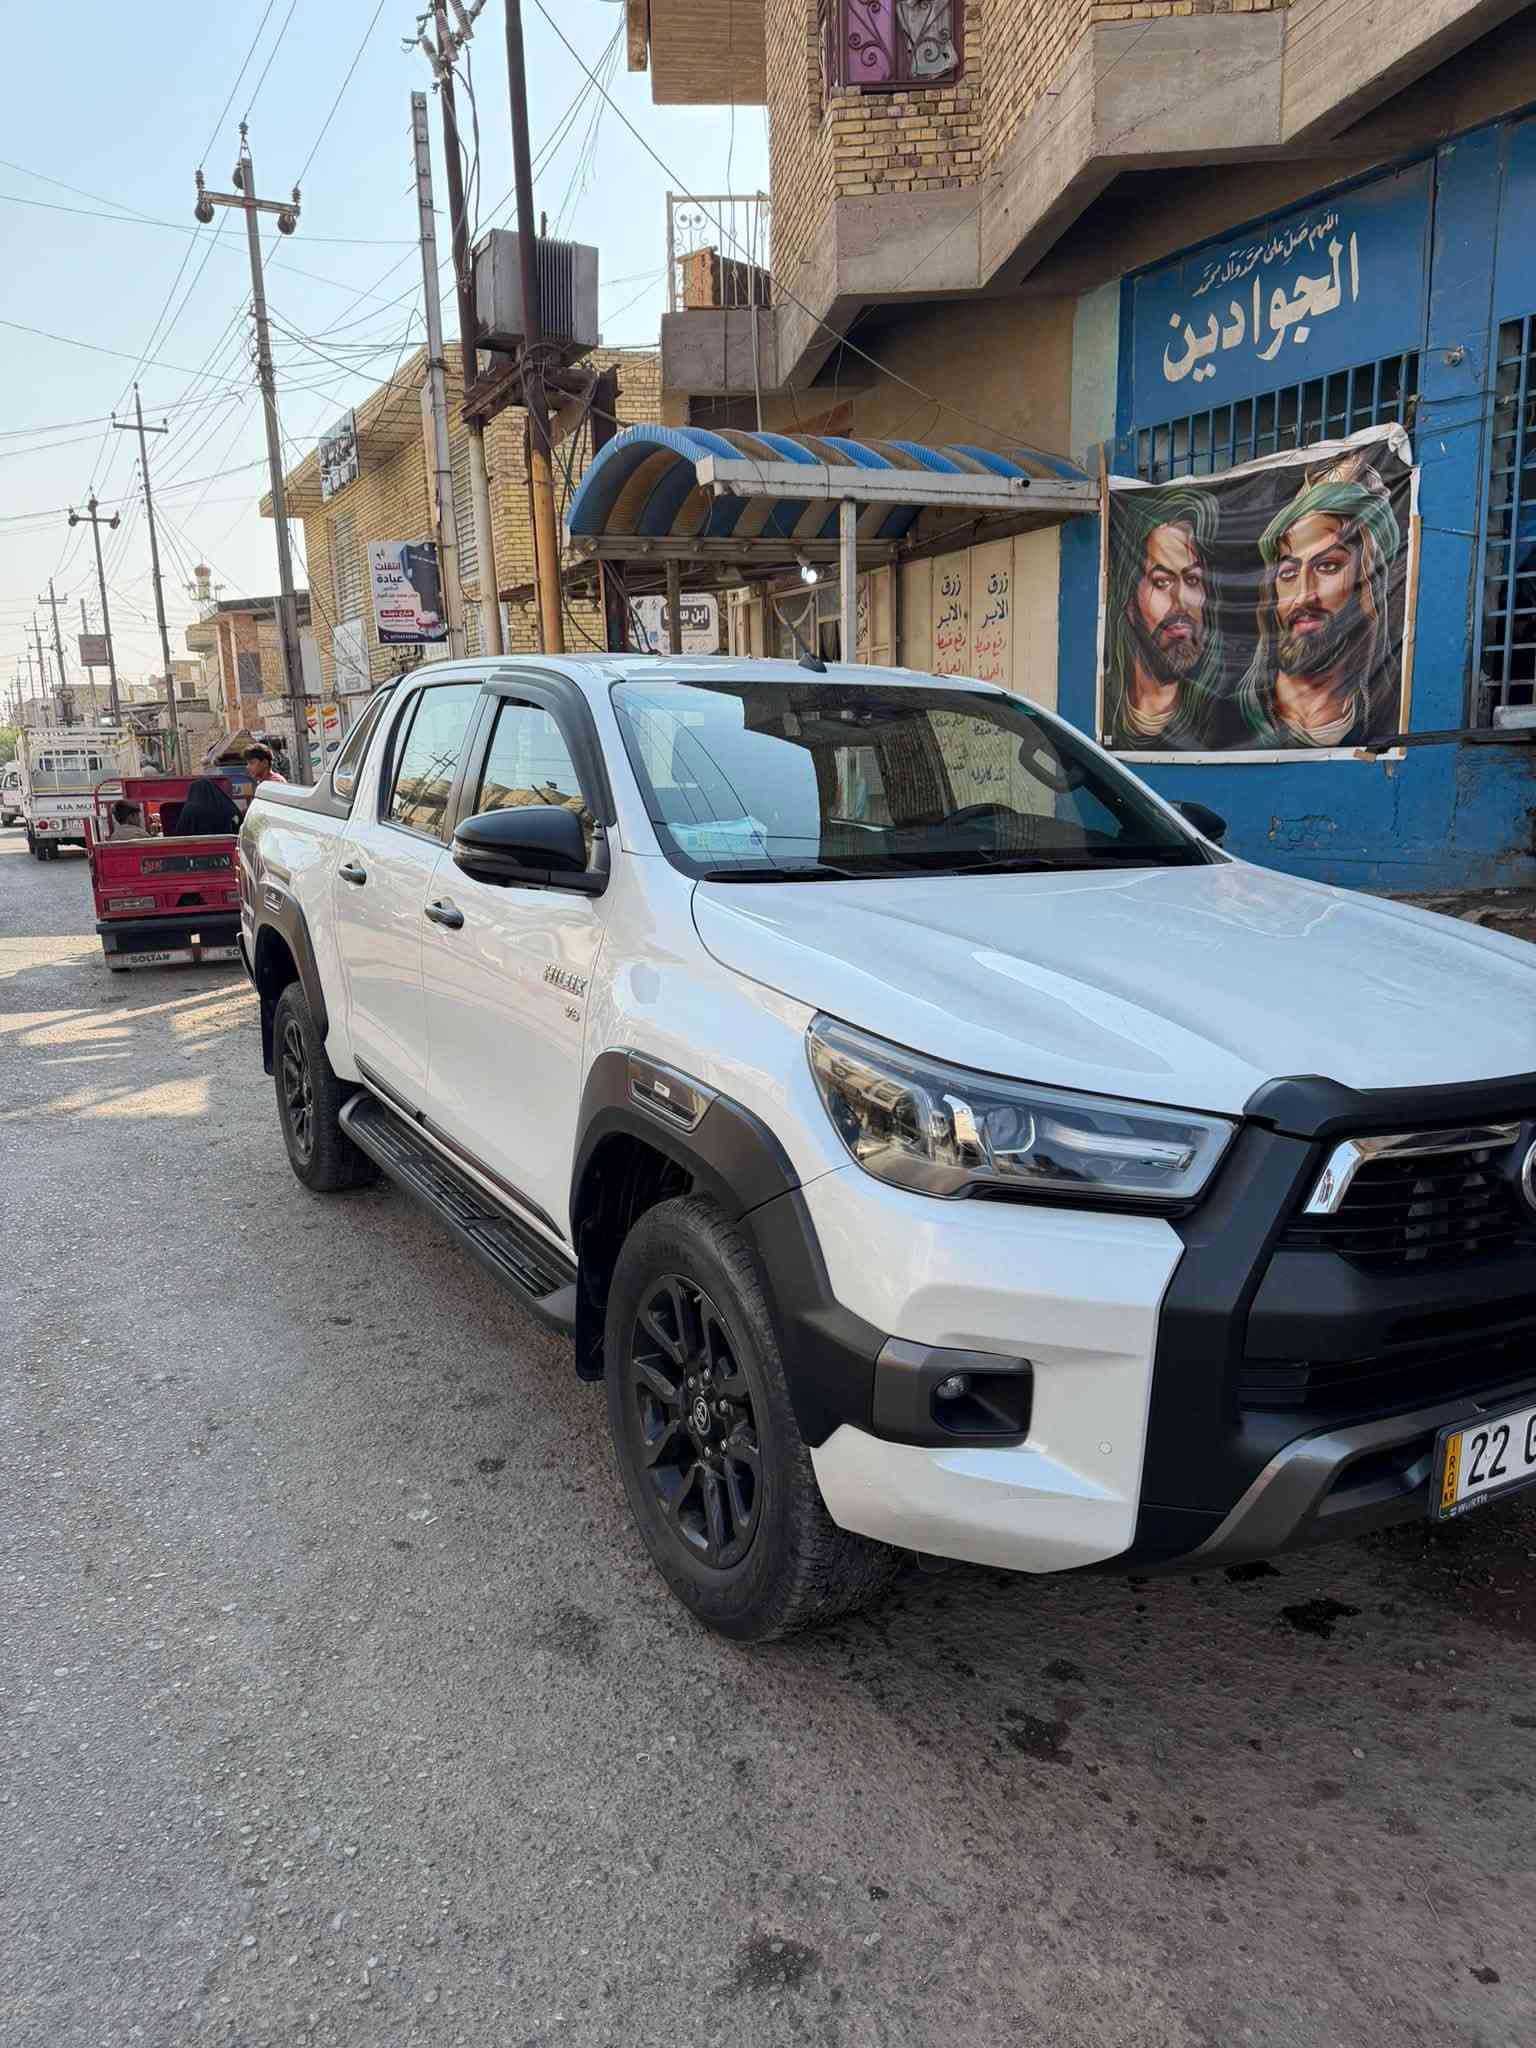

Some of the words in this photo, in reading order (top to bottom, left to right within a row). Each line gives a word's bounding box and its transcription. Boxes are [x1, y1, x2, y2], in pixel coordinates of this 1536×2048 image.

[1162, 232, 1359, 382] الجوادين
[377, 573, 404, 585] عيادة
[941, 574, 962, 596] زرق
[987, 572, 1009, 594] زرق
[691, 607, 709, 624] ابن
[1468, 1424, 1510, 1486] 22
